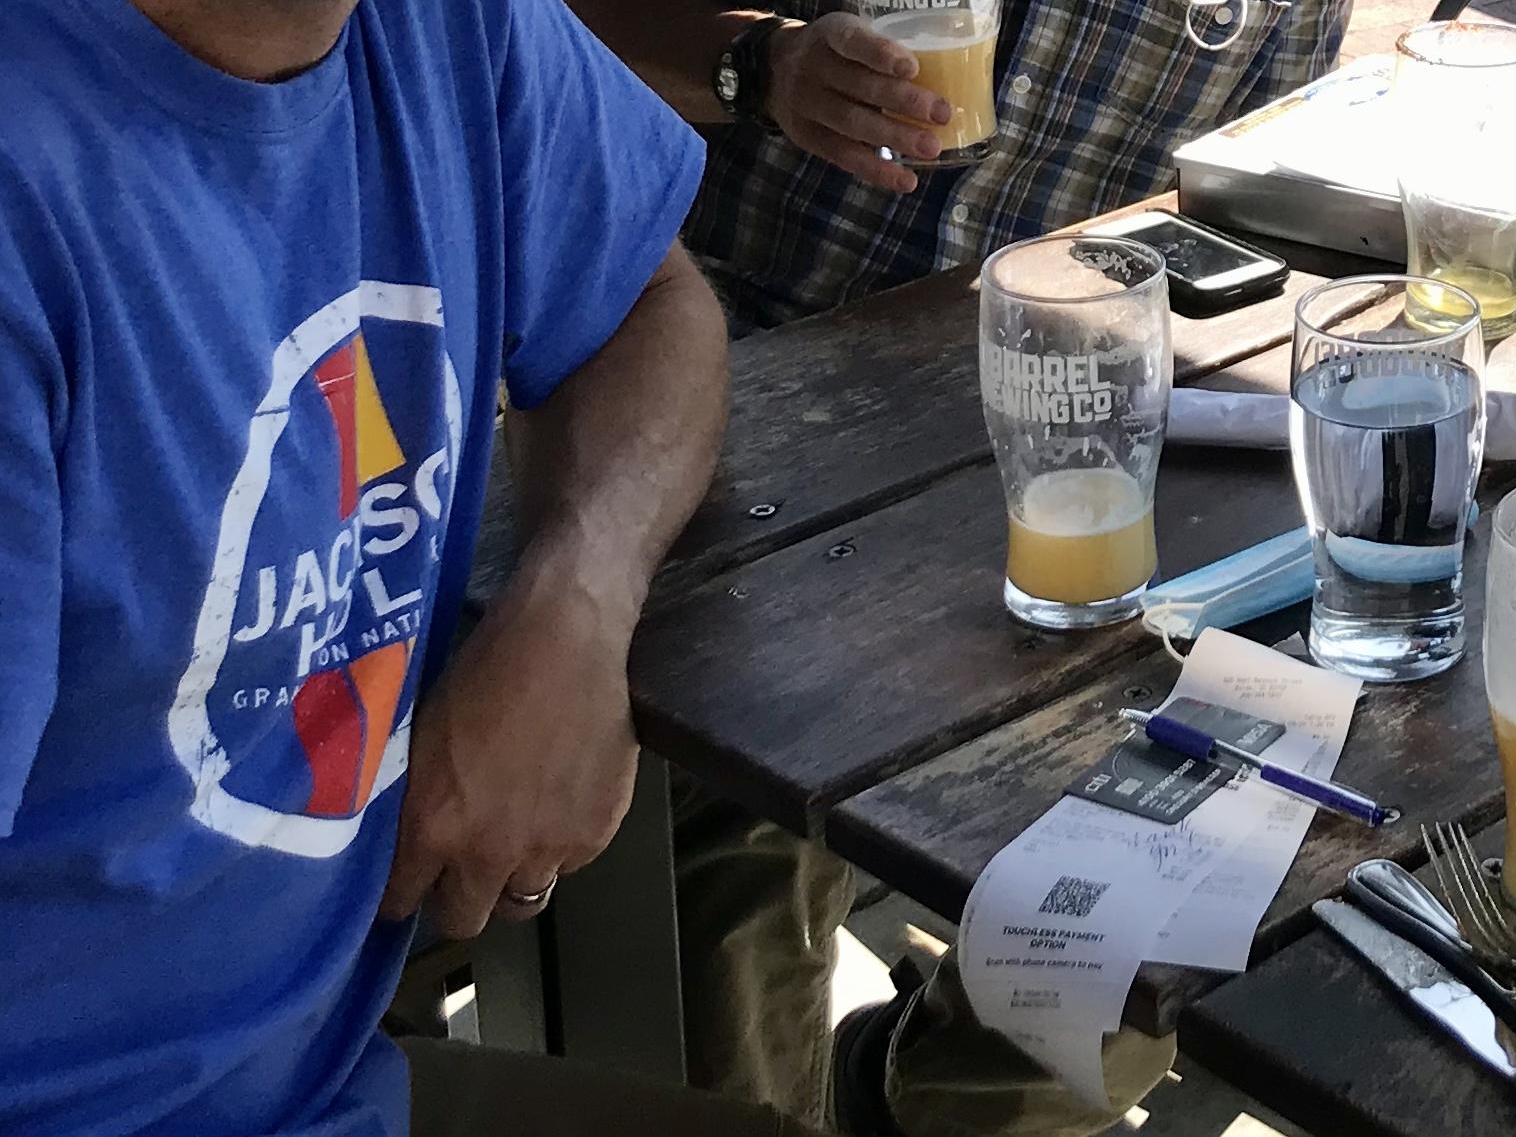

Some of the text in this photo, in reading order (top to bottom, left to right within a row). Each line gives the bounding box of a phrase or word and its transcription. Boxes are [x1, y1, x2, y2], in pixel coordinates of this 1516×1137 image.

[1003, 925, 1105, 943] TOUCHLESS PAYMENT
[1029, 938, 1067, 949] OPTION
